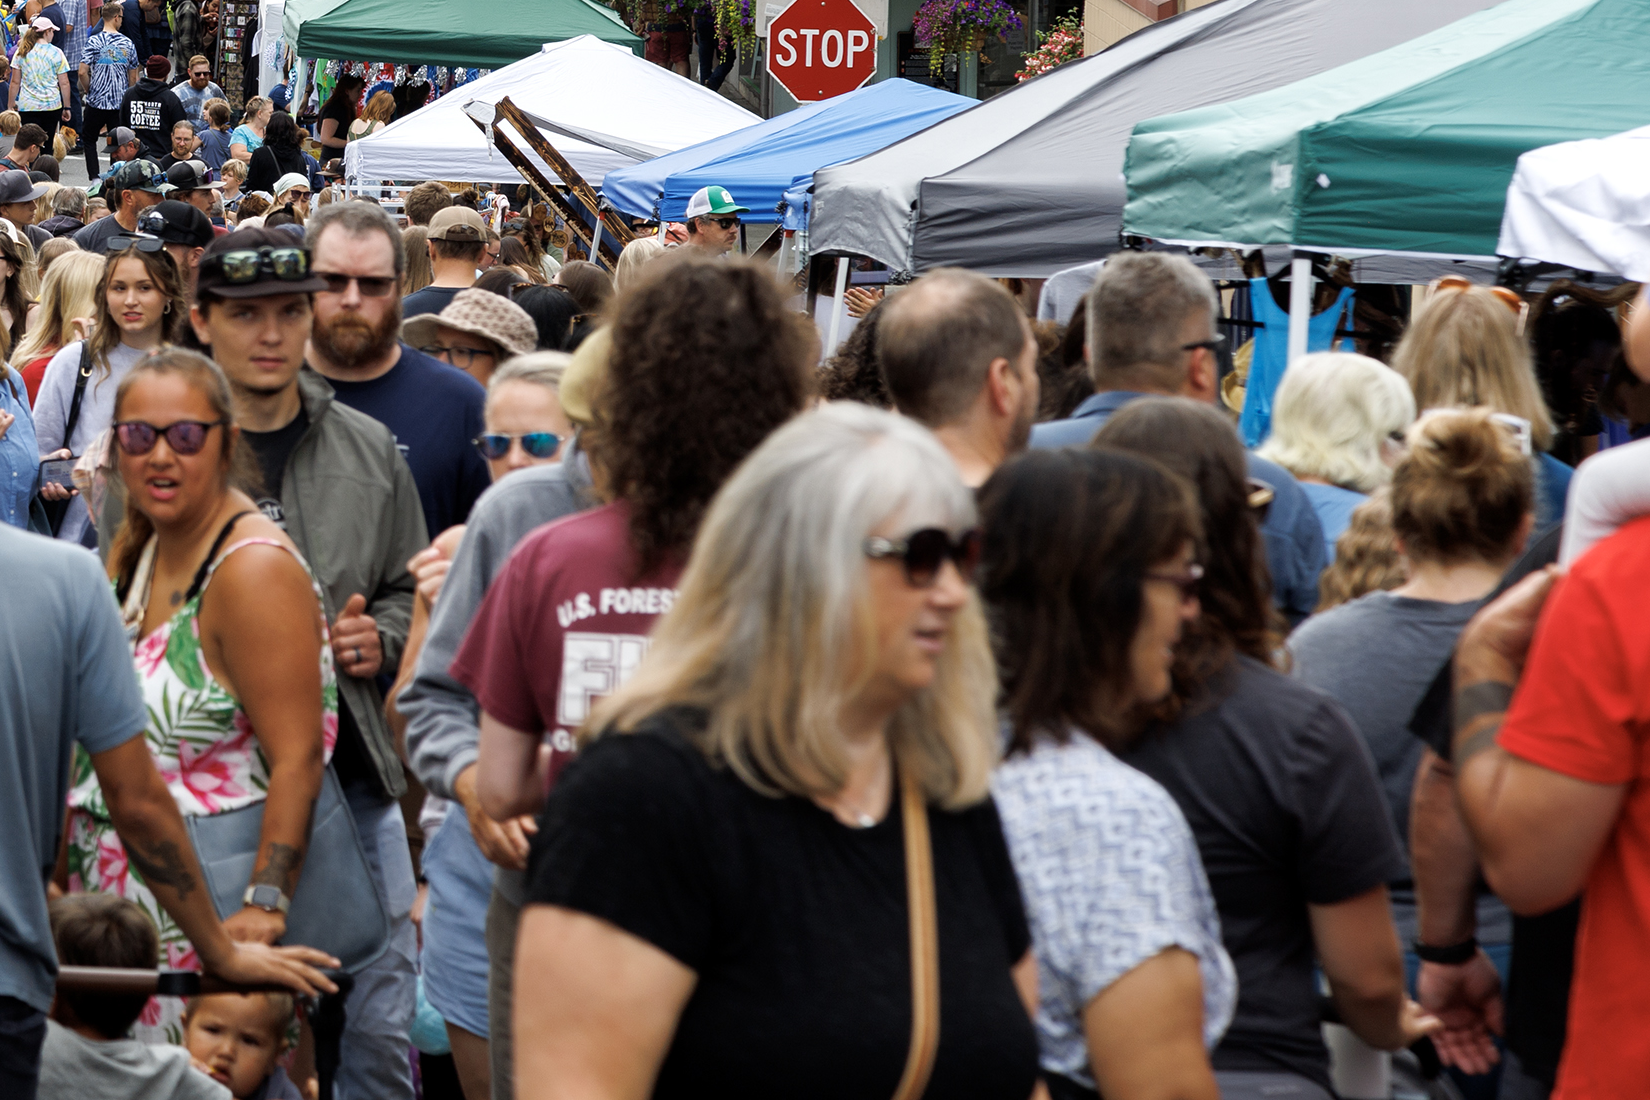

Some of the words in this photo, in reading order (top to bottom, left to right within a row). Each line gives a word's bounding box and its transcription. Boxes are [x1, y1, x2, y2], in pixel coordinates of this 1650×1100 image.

[775, 28, 870, 68] STOP
[130, 100, 144, 114] 55
[130, 113, 161, 127] COFFEE
[556, 592, 596, 628] U.S.
[600, 587, 681, 615] FORES
